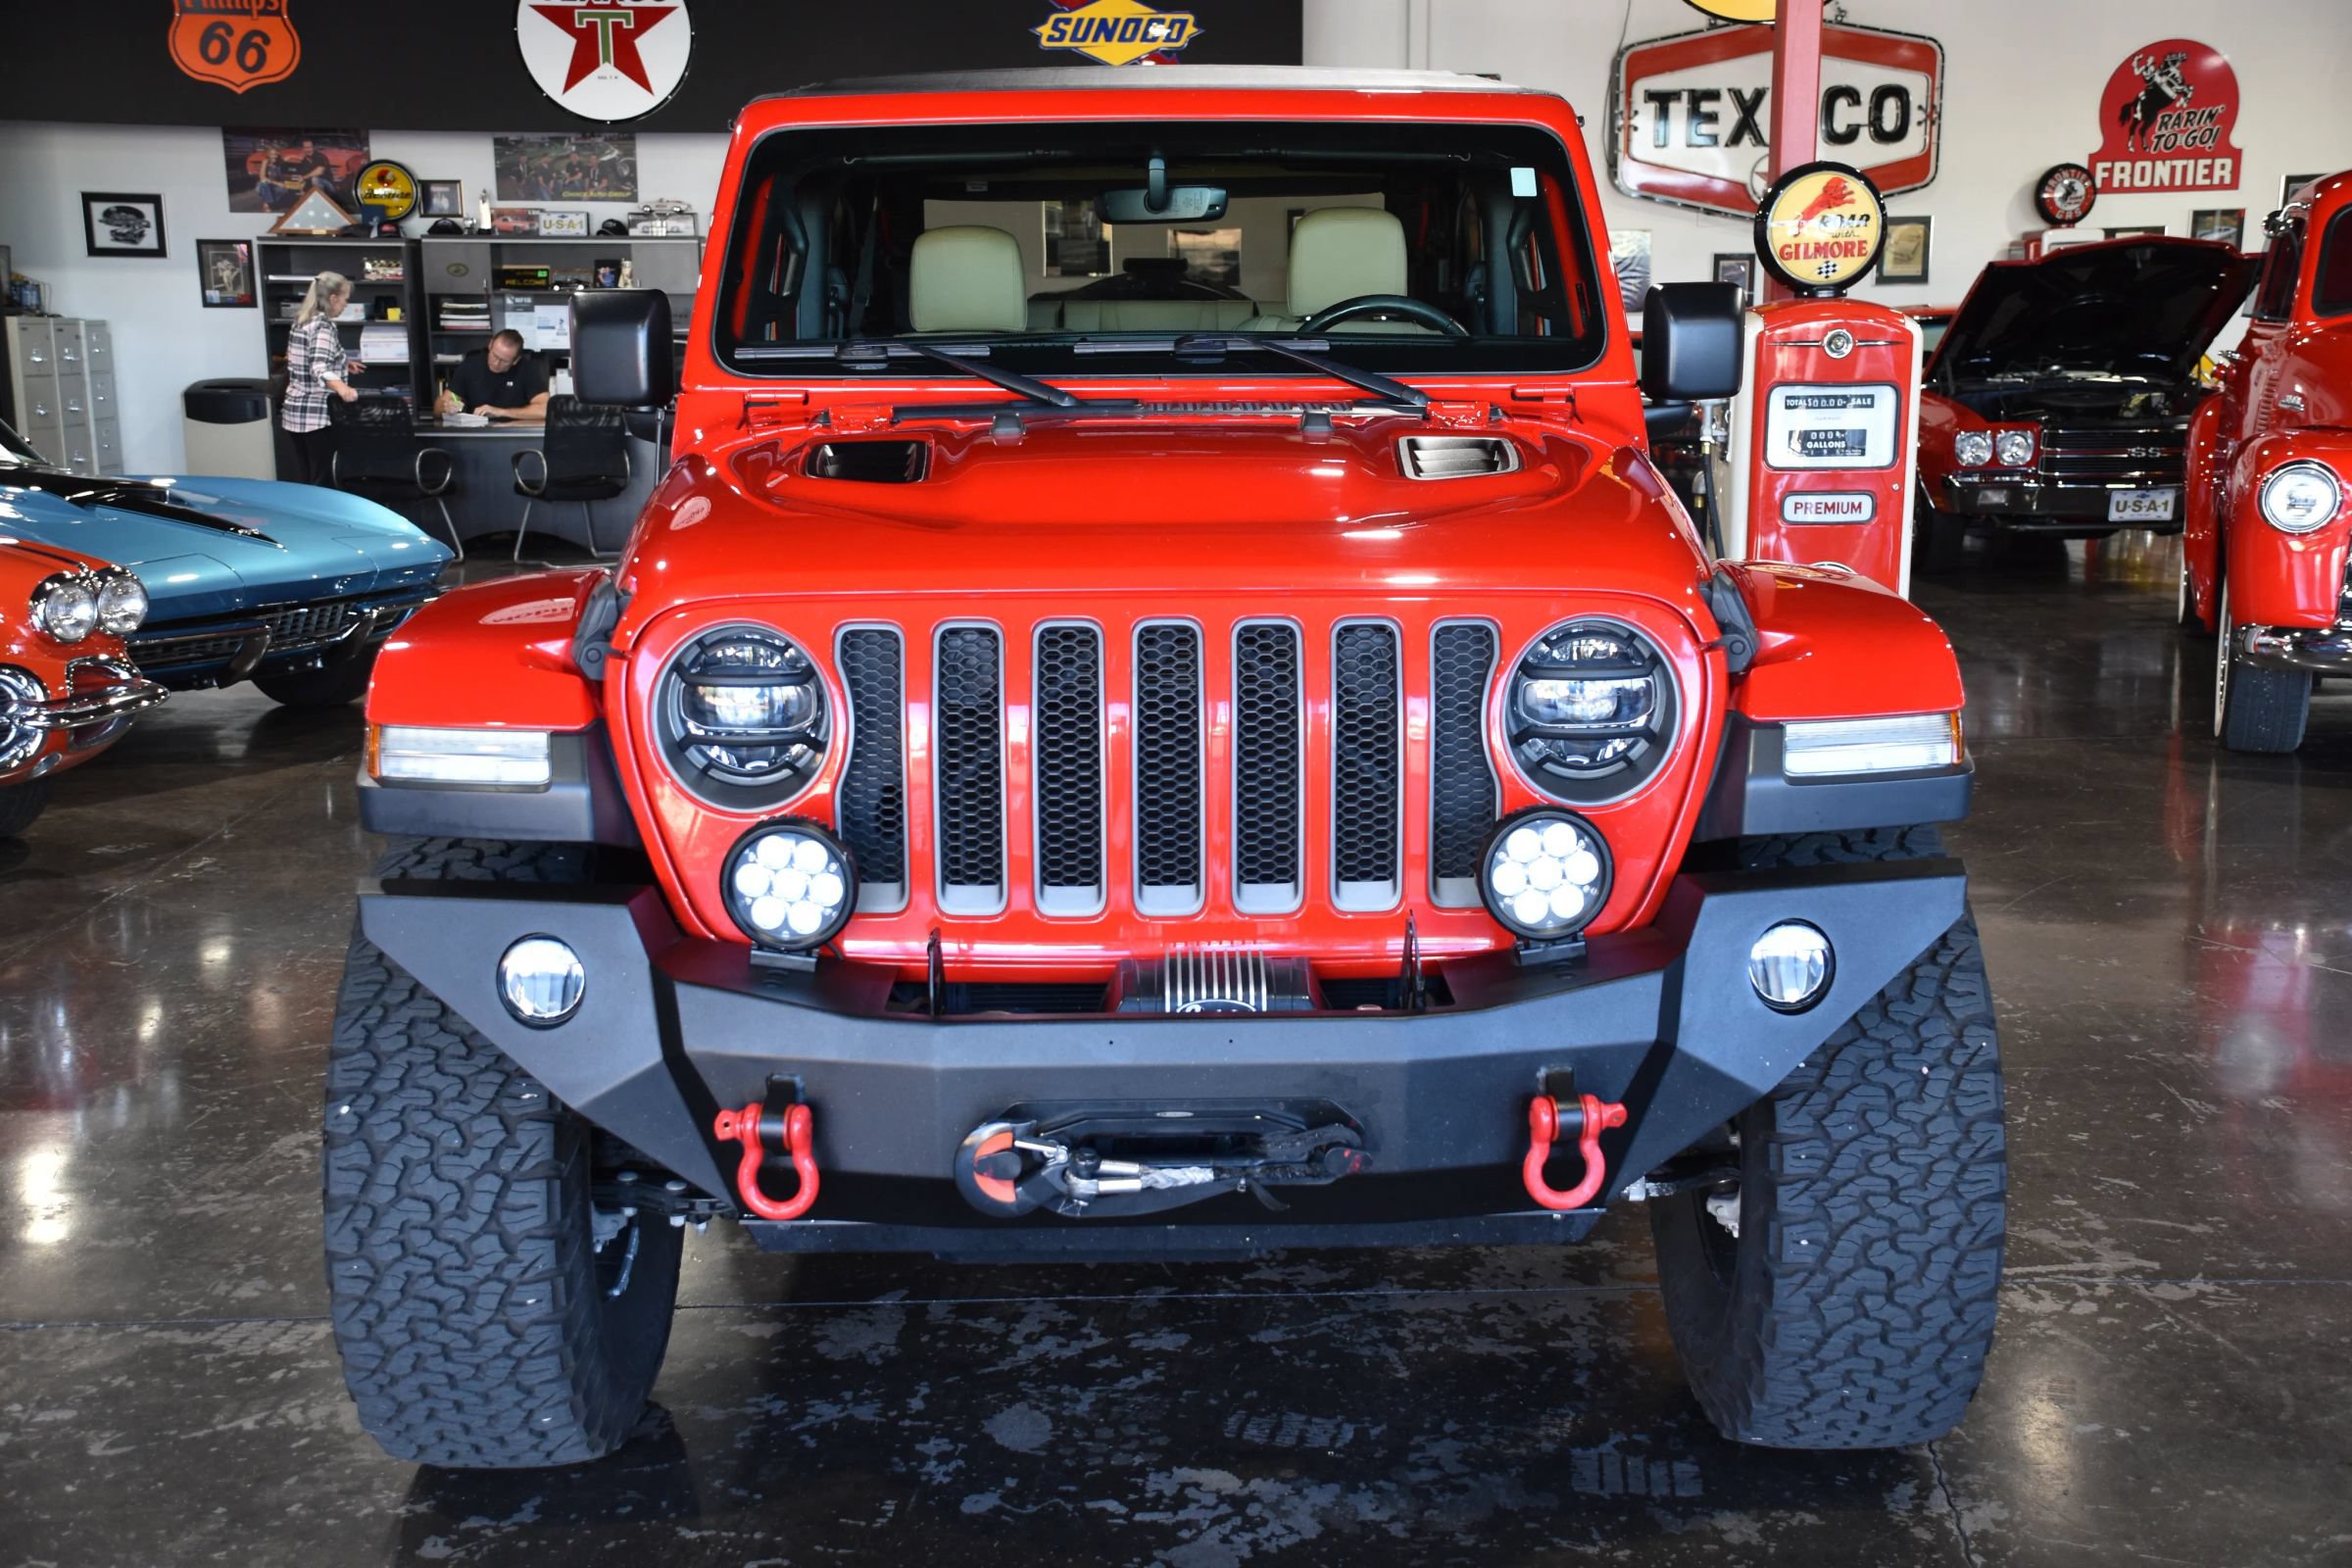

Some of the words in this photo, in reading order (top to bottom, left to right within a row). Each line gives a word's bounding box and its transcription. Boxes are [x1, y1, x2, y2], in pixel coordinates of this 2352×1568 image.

[574, 10, 635, 66] T
[1047, 17, 1190, 43] SUNOCO
[199, 21, 272, 74] 66
[1643, 84, 1911, 148] TEXCO
[2157, 105, 2226, 132] RARIN'
[2152, 132, 2178, 153] TO
[2184, 125, 2222, 150] GO!
[2095, 158, 2234, 188] FRONTIER
[1779, 240, 1869, 262] GILMORE
[1850, 397, 1873, 406] SALE
[1793, 502, 1863, 514] PREMIUM
